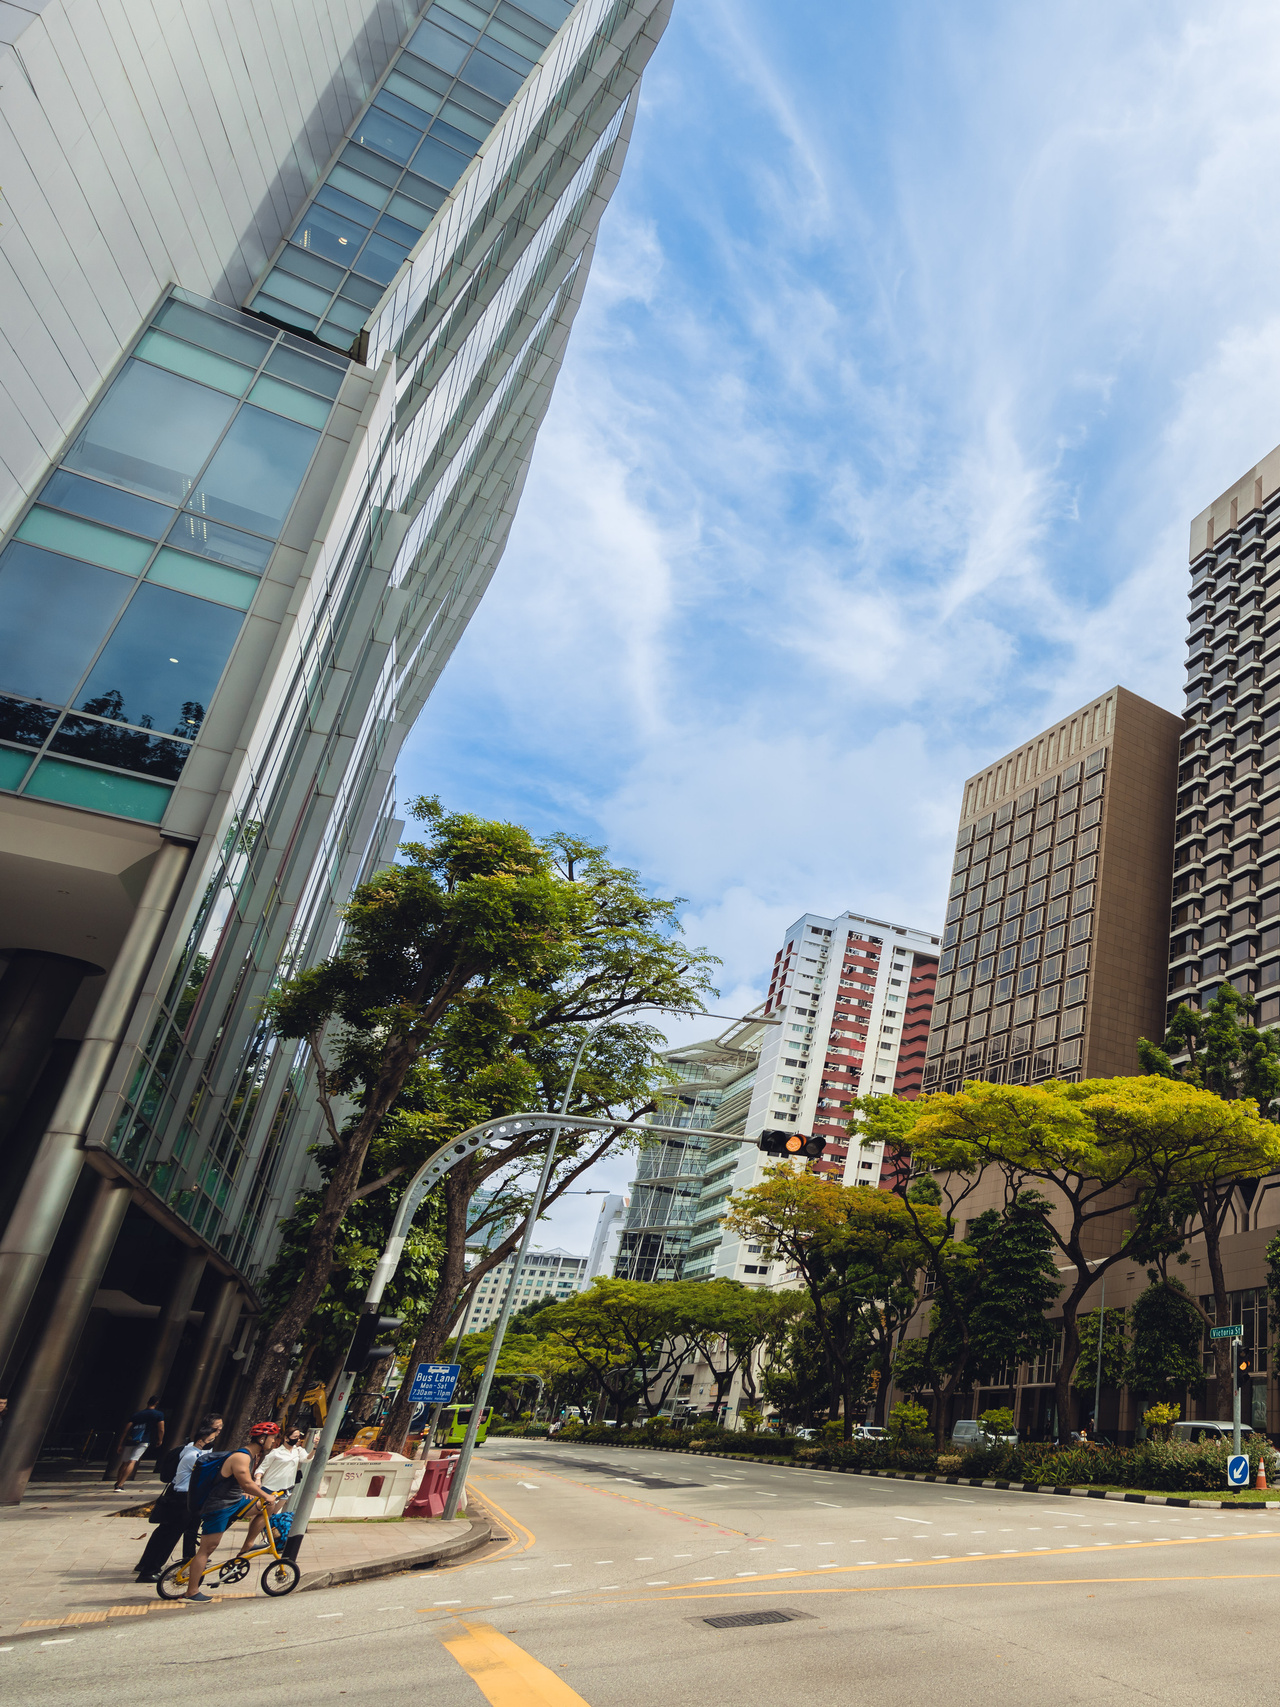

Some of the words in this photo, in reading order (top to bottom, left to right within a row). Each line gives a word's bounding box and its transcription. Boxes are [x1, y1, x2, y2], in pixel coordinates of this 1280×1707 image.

[1213, 1328, 1233, 1337] Victoria
[1235, 1327, 1241, 1335] St
[416, 1372, 433, 1382] Bus
[434, 1373, 455, 1383] Lane
[338, 1392, 344, 1401] 6
